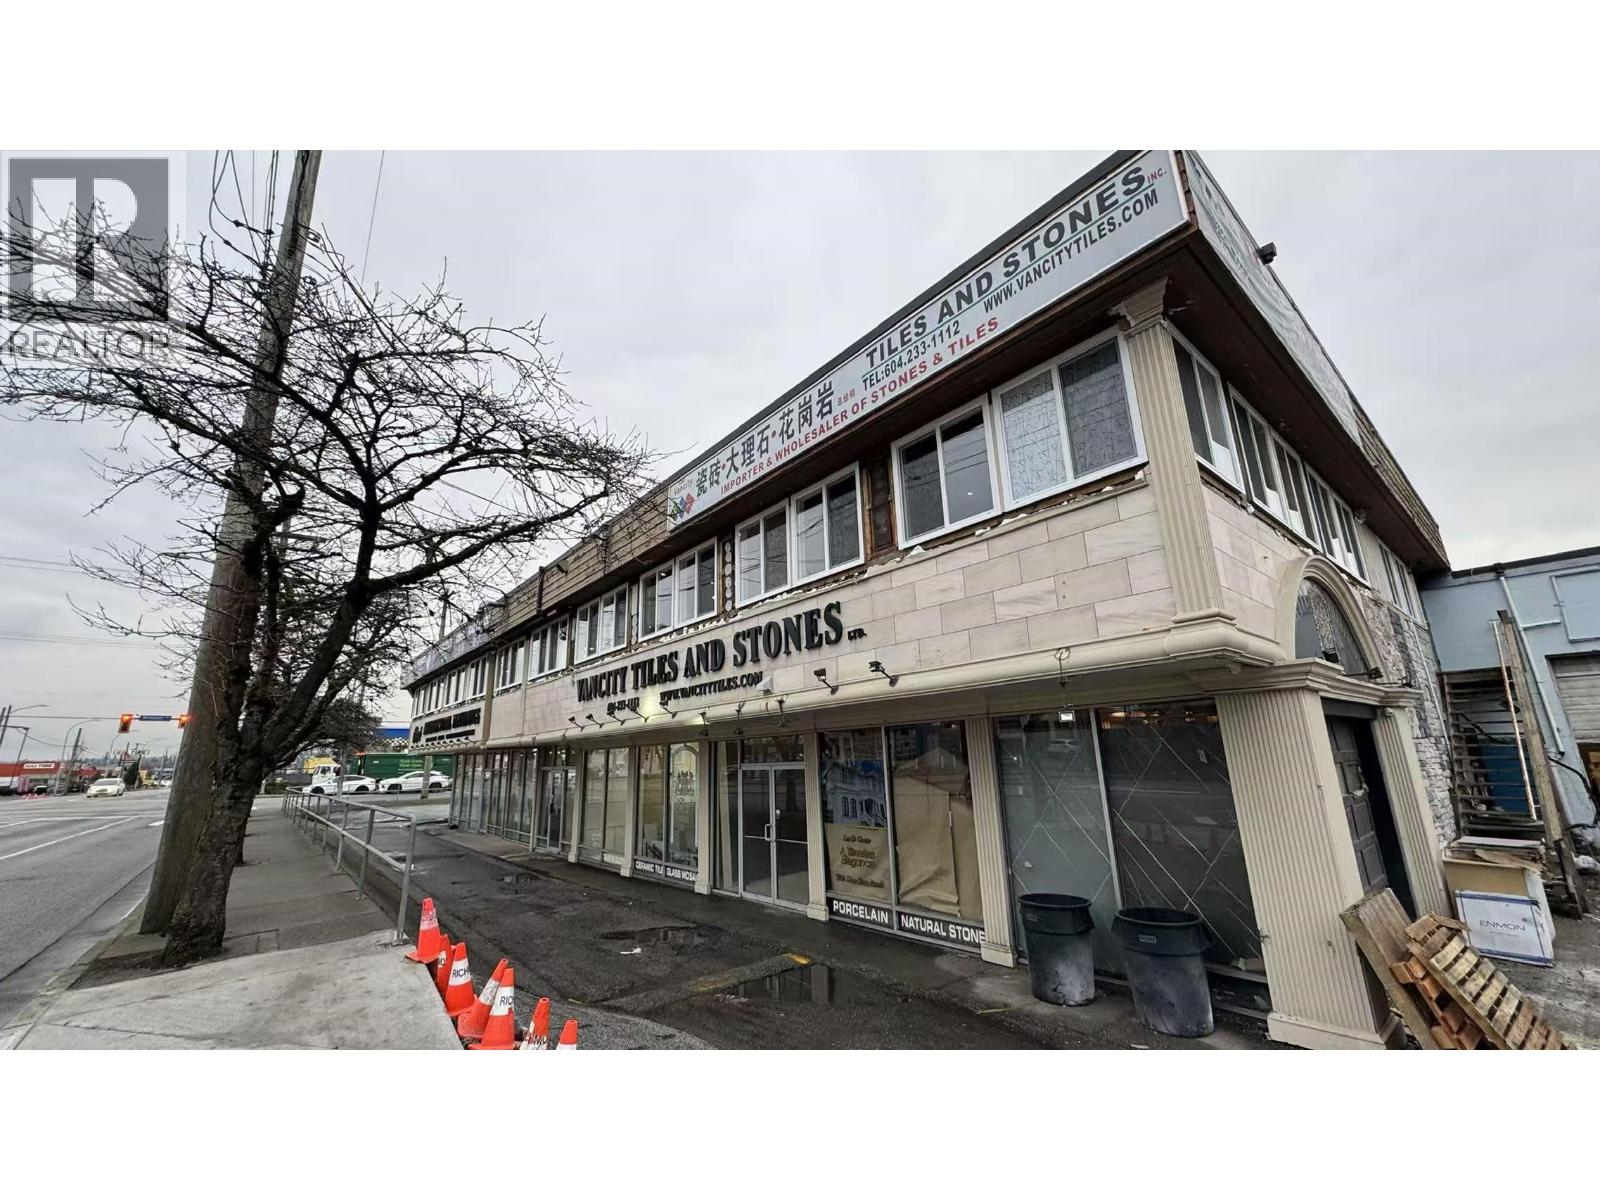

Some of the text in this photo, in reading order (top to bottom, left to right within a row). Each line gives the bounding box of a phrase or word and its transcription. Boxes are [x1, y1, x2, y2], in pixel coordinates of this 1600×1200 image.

[1147, 167, 1167, 184] INC.
[866, 316, 926, 368] TILES
[938, 271, 993, 323] AND
[1002, 166, 1146, 277] STONES
[983, 187, 1159, 314] WWW.VANCITYTILES.COM
[862, 321, 961, 392] TEL:604.233-1112
[720, 460, 764, 495] IMPORTER
[766, 456, 773, 468] &
[774, 409, 849, 462] WHOLESALER
[850, 397, 868, 415] OF
[870, 359, 928, 404] STONES
[932, 352, 943, 366] &
[948, 317, 999, 355] TILES
[577, 667, 628, 702] VANCITY
[630, 651, 678, 690] TILES
[683, 638, 726, 679] AND
[732, 601, 844, 668] STONES
[833, 900, 888, 924] PORCELAIN
[901, 914, 947, 937] NATURAL
[1480, 920, 1525, 931] ENMON
